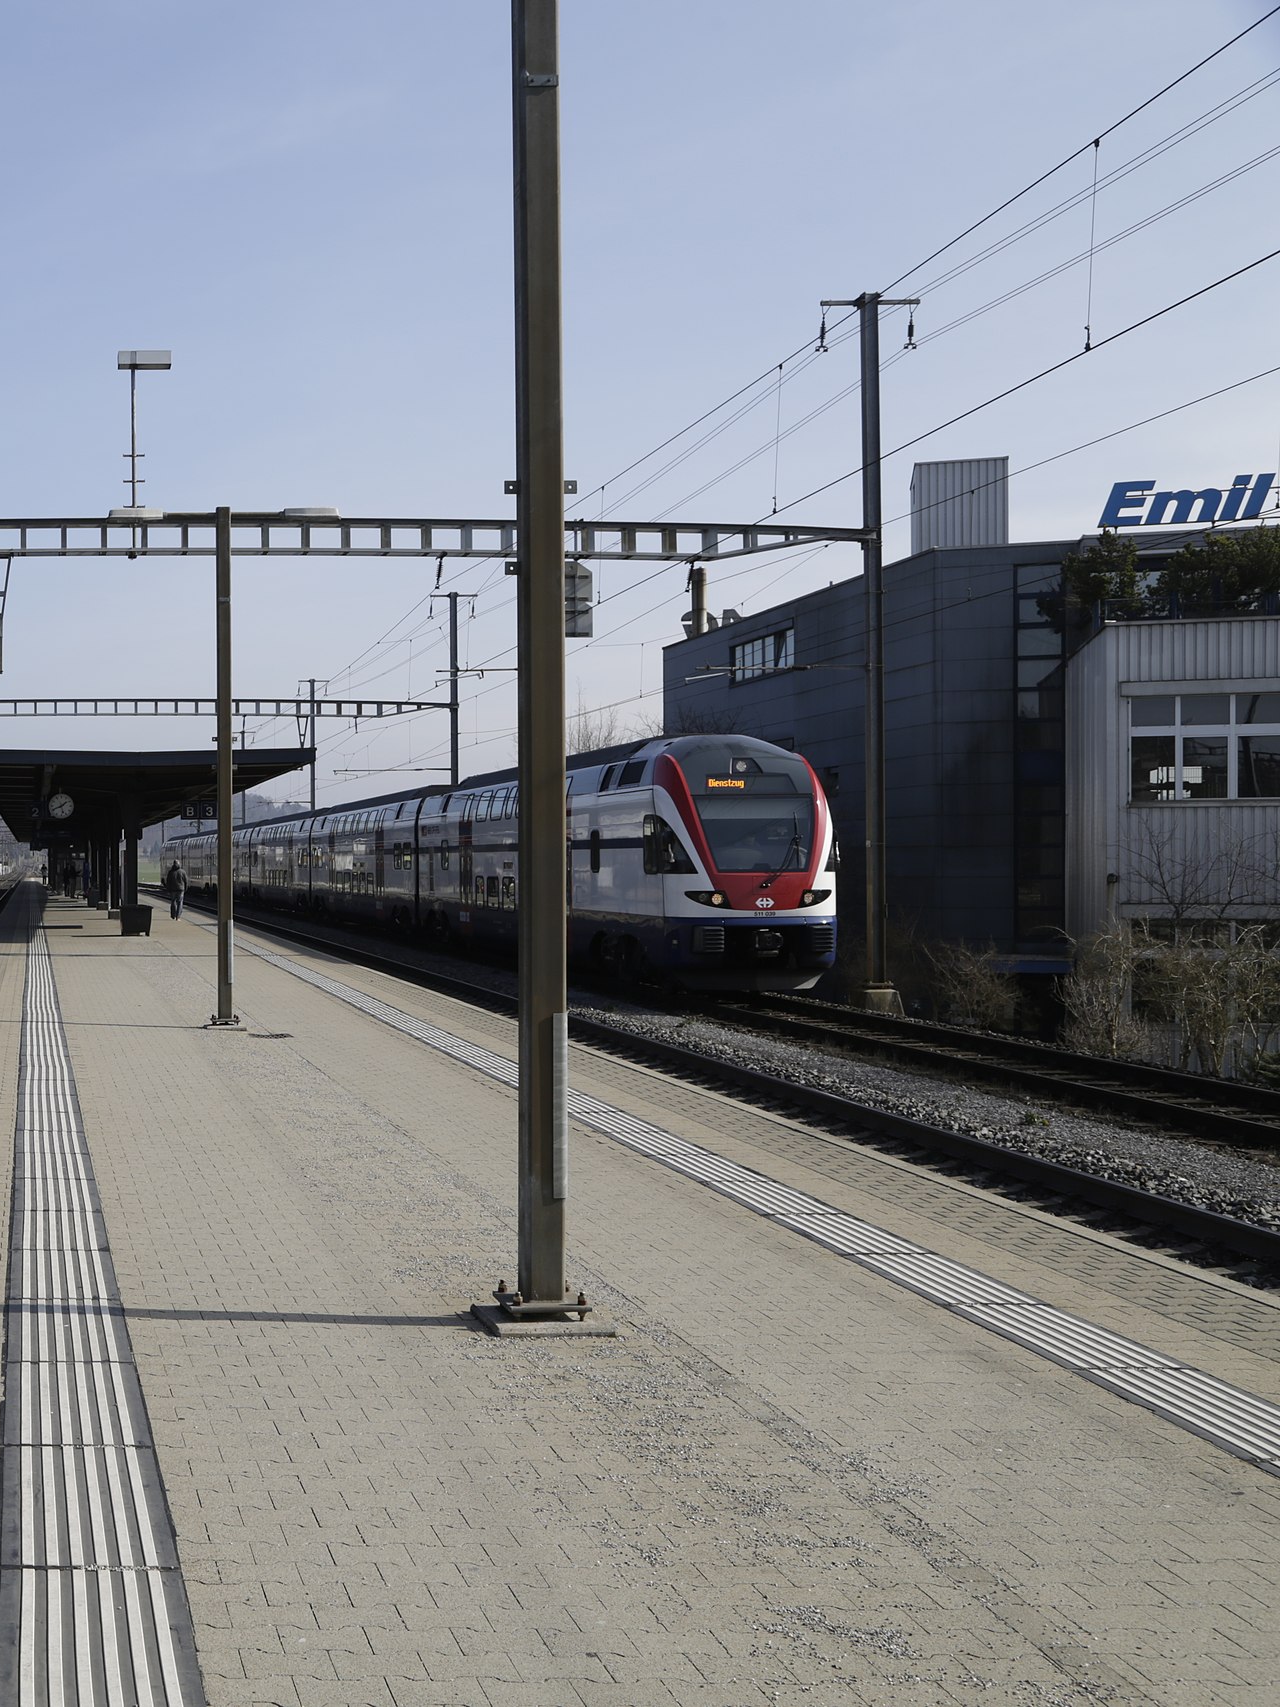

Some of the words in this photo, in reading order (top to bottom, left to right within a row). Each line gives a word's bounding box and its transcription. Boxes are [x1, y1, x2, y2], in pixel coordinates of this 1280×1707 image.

[1097, 473, 1276, 528] Emil
[708, 779, 744, 789] Dienstzug
[31, 807, 40, 818] 2
[186, 806, 195, 817] B
[205, 806, 214, 817] 3
